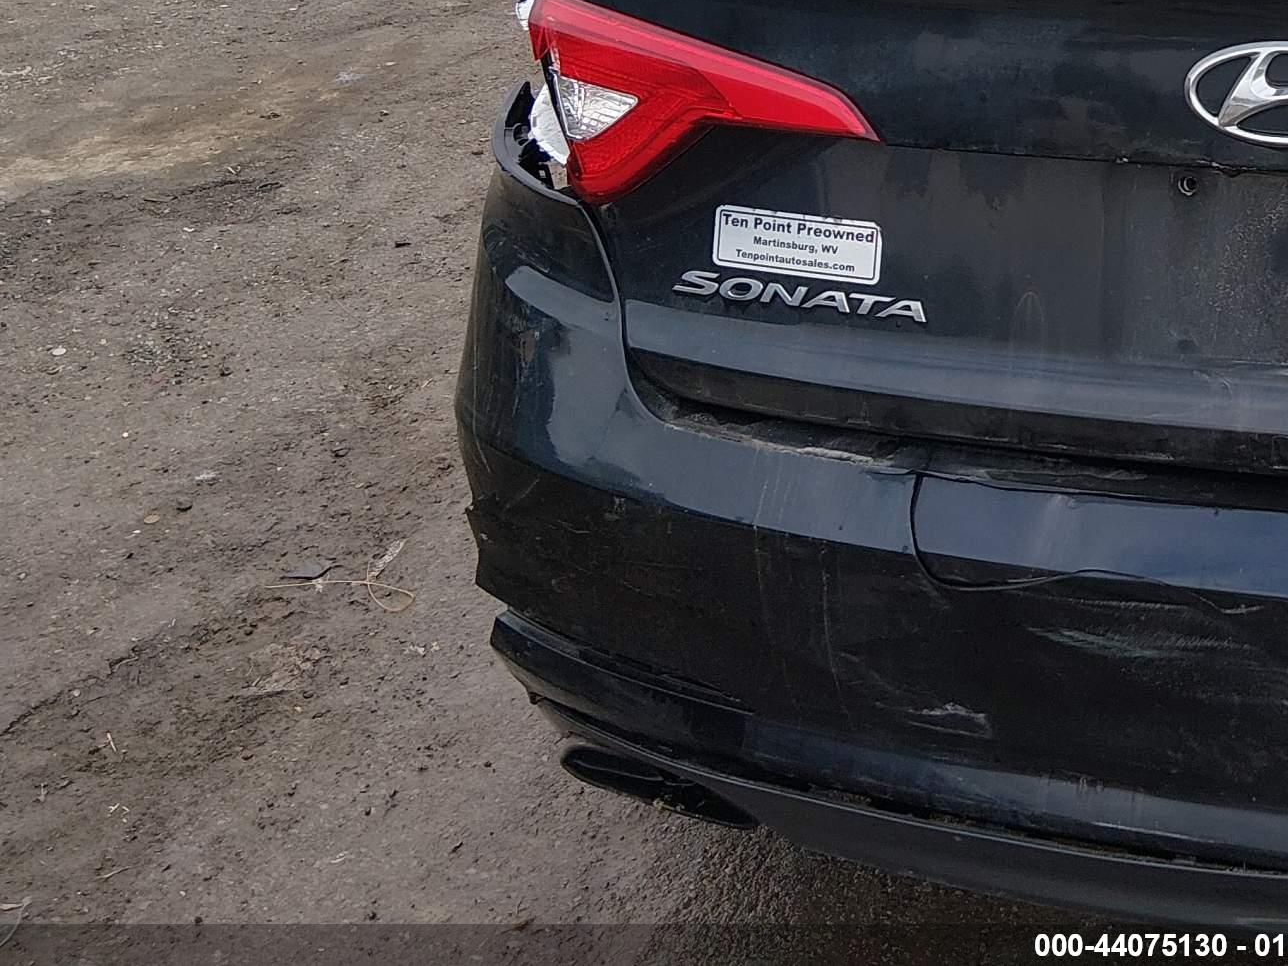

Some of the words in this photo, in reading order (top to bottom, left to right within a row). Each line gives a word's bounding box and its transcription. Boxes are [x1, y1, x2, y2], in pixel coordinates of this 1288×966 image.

[722, 213, 749, 229] Ten
[753, 217, 792, 234] Point
[797, 222, 875, 243] Preowned
[753, 236, 818, 254] Martinsburg,
[821, 244, 839, 255] WV
[735, 248, 855, 272] Tenpointautosales.com
[672, 270, 928, 323] SONATA
